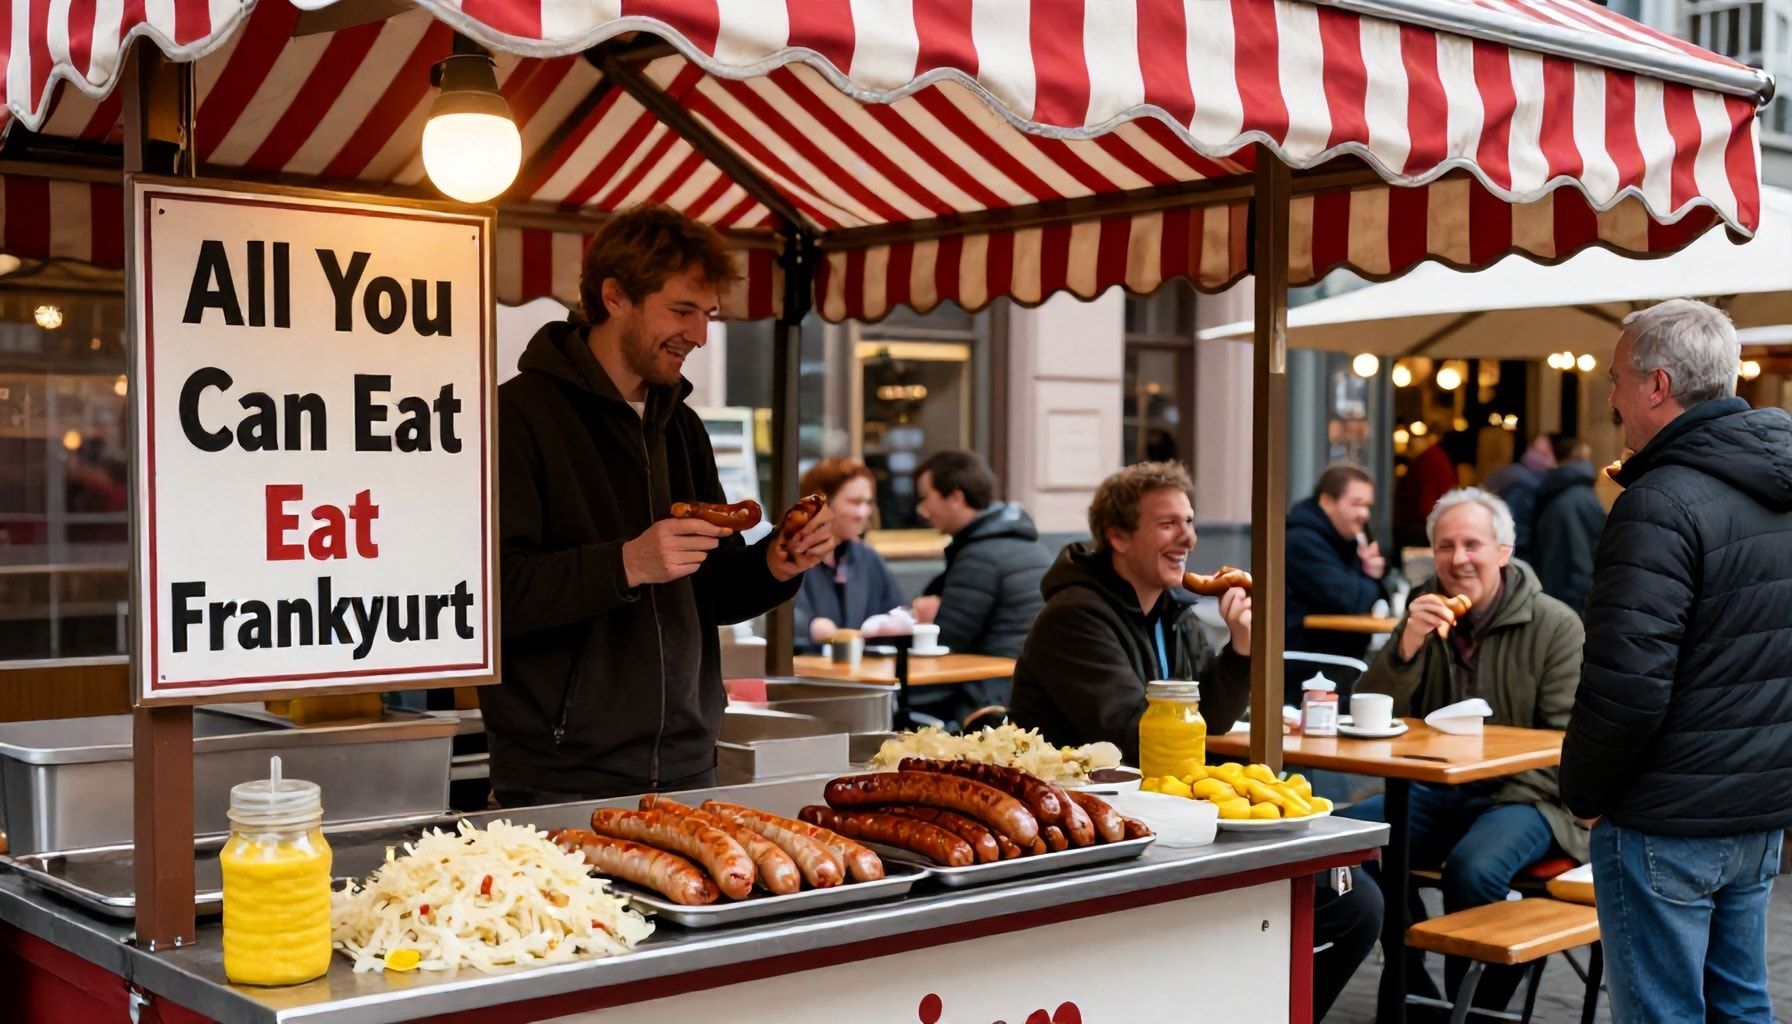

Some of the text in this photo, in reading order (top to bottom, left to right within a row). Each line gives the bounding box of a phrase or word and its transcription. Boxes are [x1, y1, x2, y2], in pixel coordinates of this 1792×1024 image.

[182, 240, 452, 336] All You
[179, 367, 462, 453] Can Eat
[265, 484, 379, 560] Eat
[171, 576, 474, 660] Frankyurt
